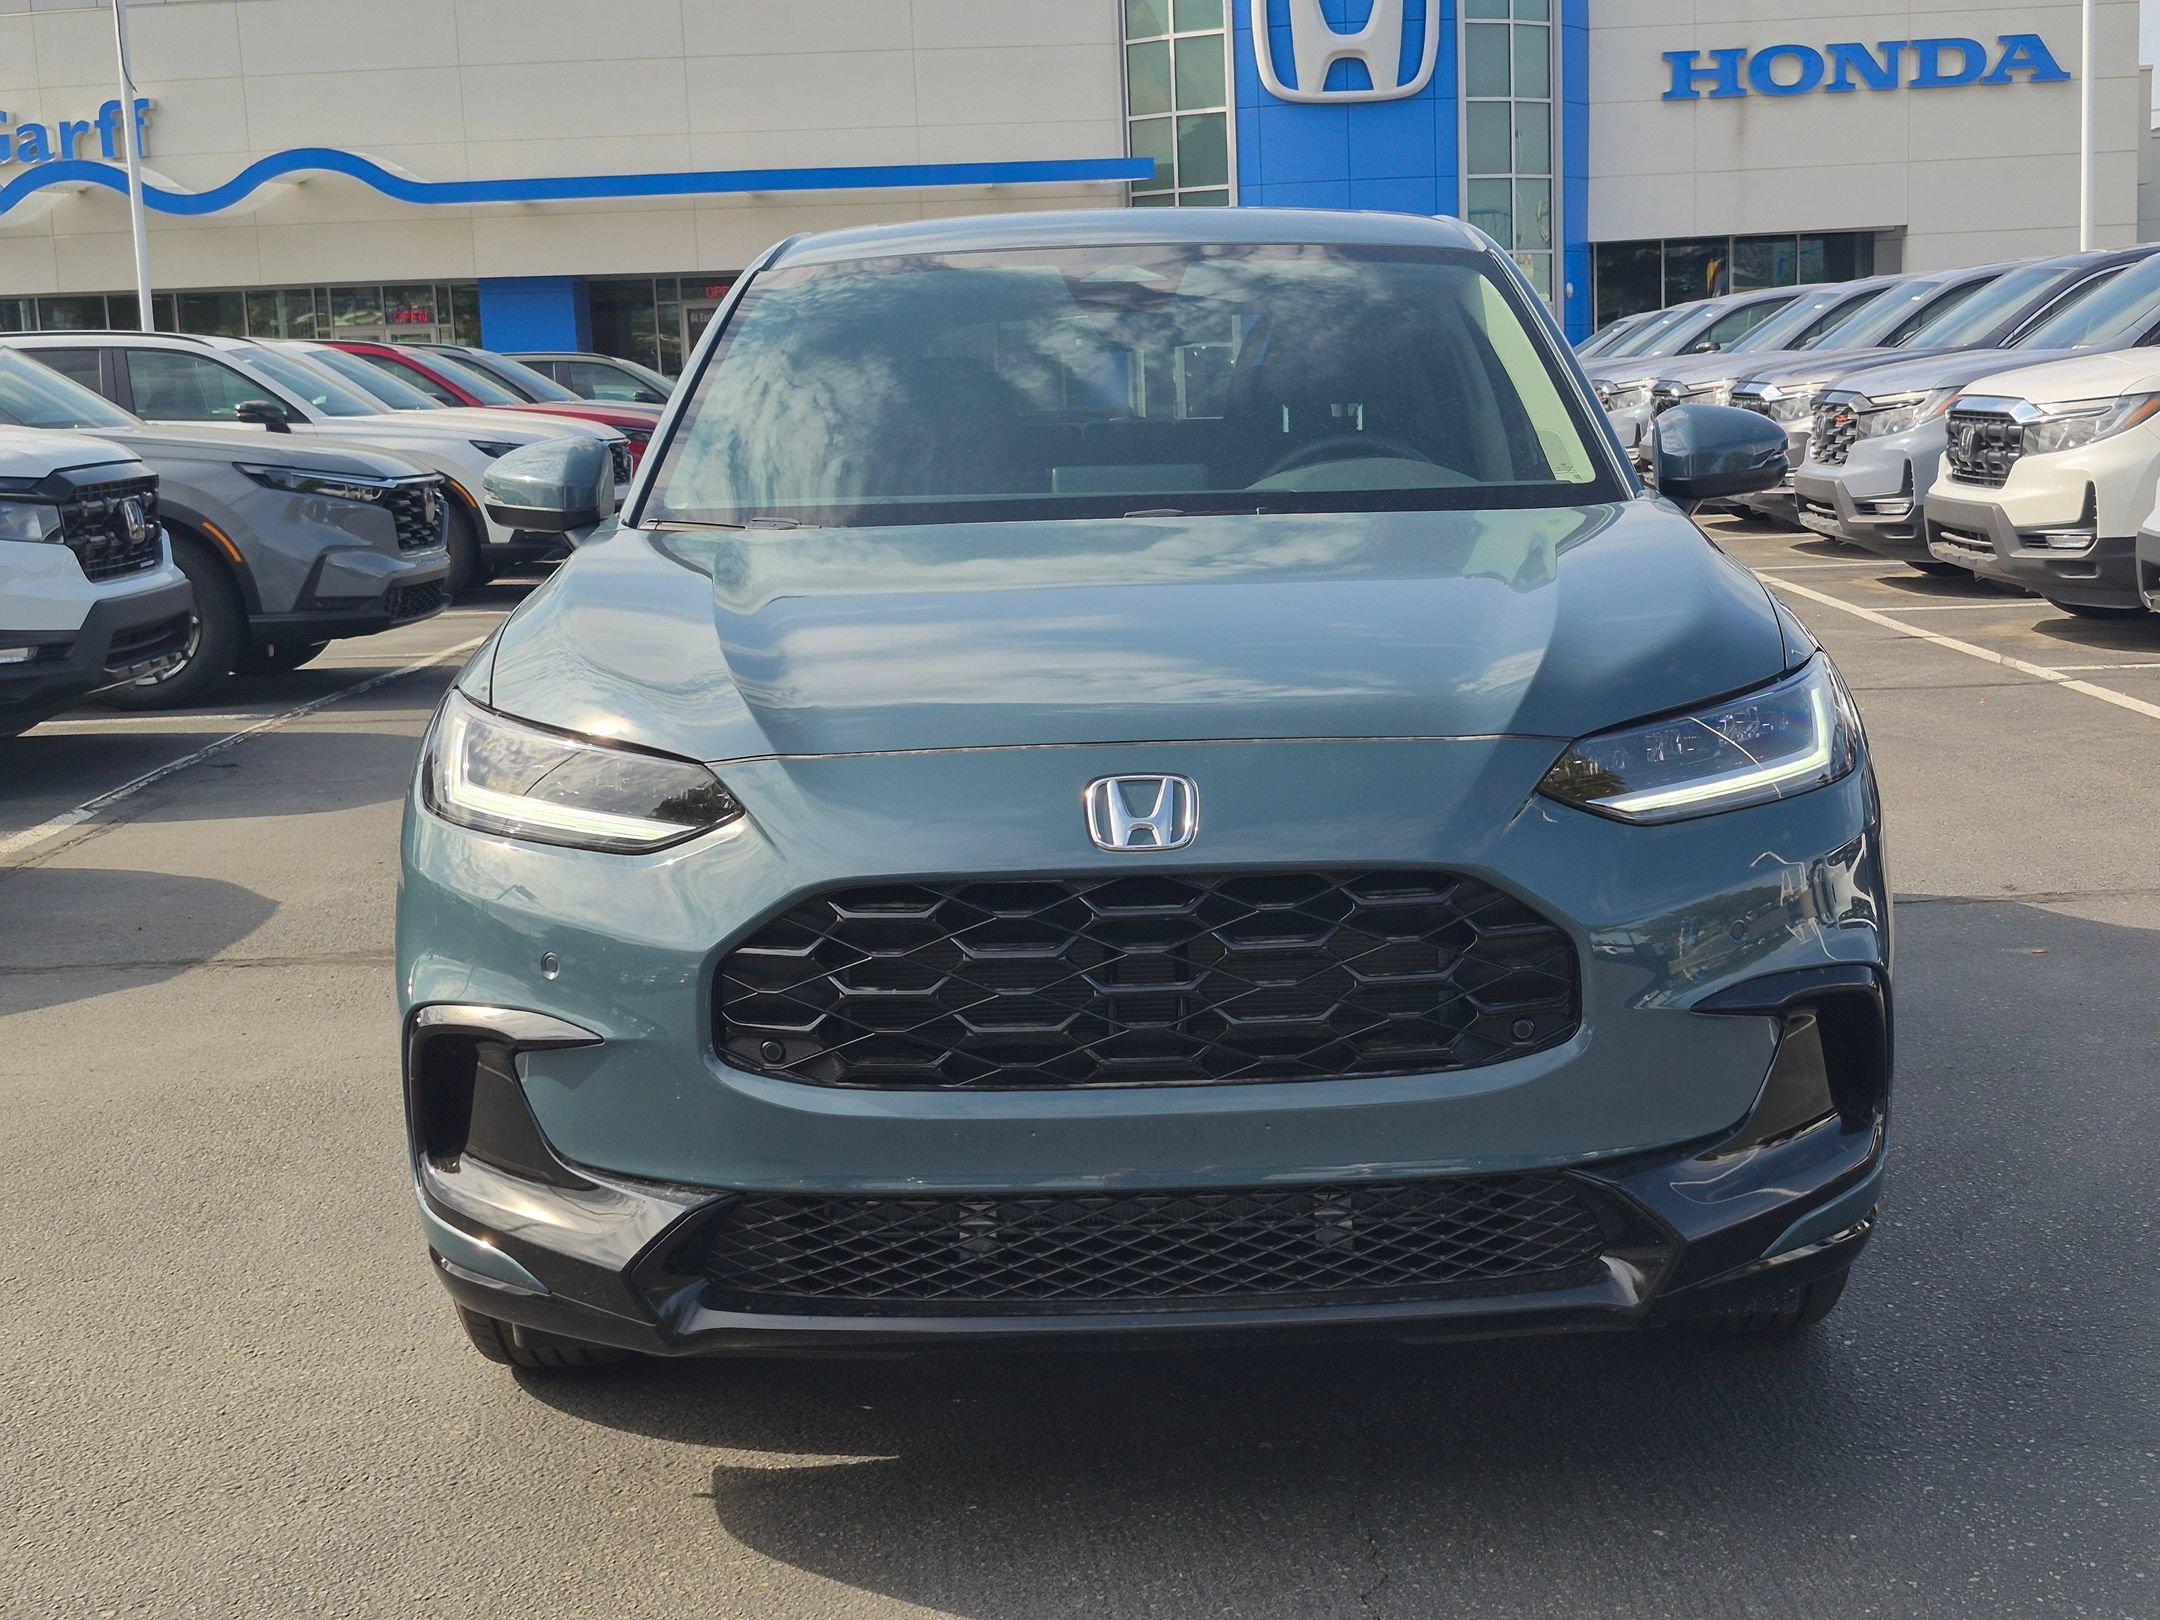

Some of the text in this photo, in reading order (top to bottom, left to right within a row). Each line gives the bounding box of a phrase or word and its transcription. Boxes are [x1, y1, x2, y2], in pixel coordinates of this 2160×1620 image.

[1661, 33, 2072, 100] HONDA
[705, 285, 731, 298] OPE
[395, 310, 429, 323] OPEN
